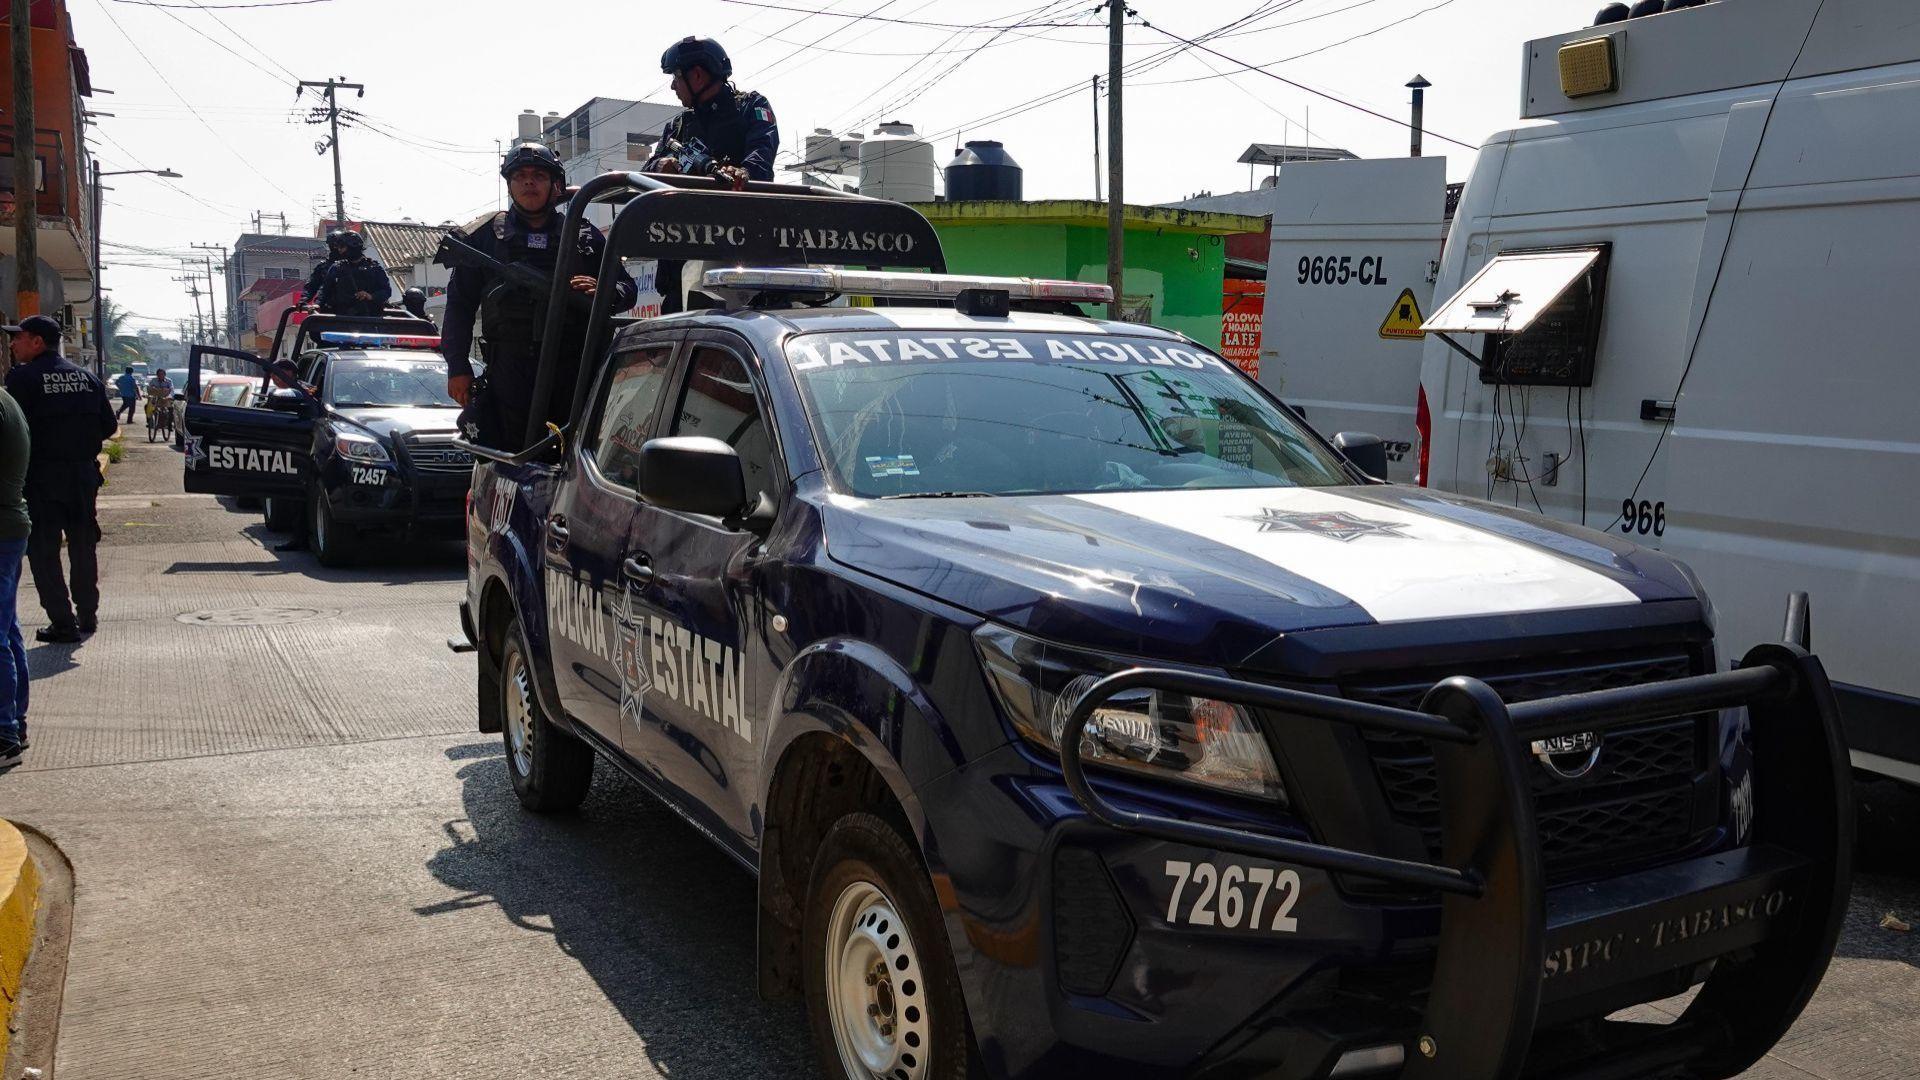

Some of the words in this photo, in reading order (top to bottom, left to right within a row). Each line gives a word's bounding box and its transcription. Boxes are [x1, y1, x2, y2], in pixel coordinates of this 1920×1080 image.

[649, 222, 746, 246] SSYPC
[773, 226, 915, 252] TABASCO
[1297, 256, 1388, 286] 9665-CL
[1228, 323, 1262, 333] HOJALD
[43, 382, 94, 394] ESTATAL
[208, 445, 299, 475] ESTATAL
[352, 467, 387, 485] 72457
[549, 569, 609, 661] POLICIA
[651, 615, 752, 743] ESTATAL
[1165, 860, 1301, 932] 72672
[1652, 890, 1783, 948] TABASCO
